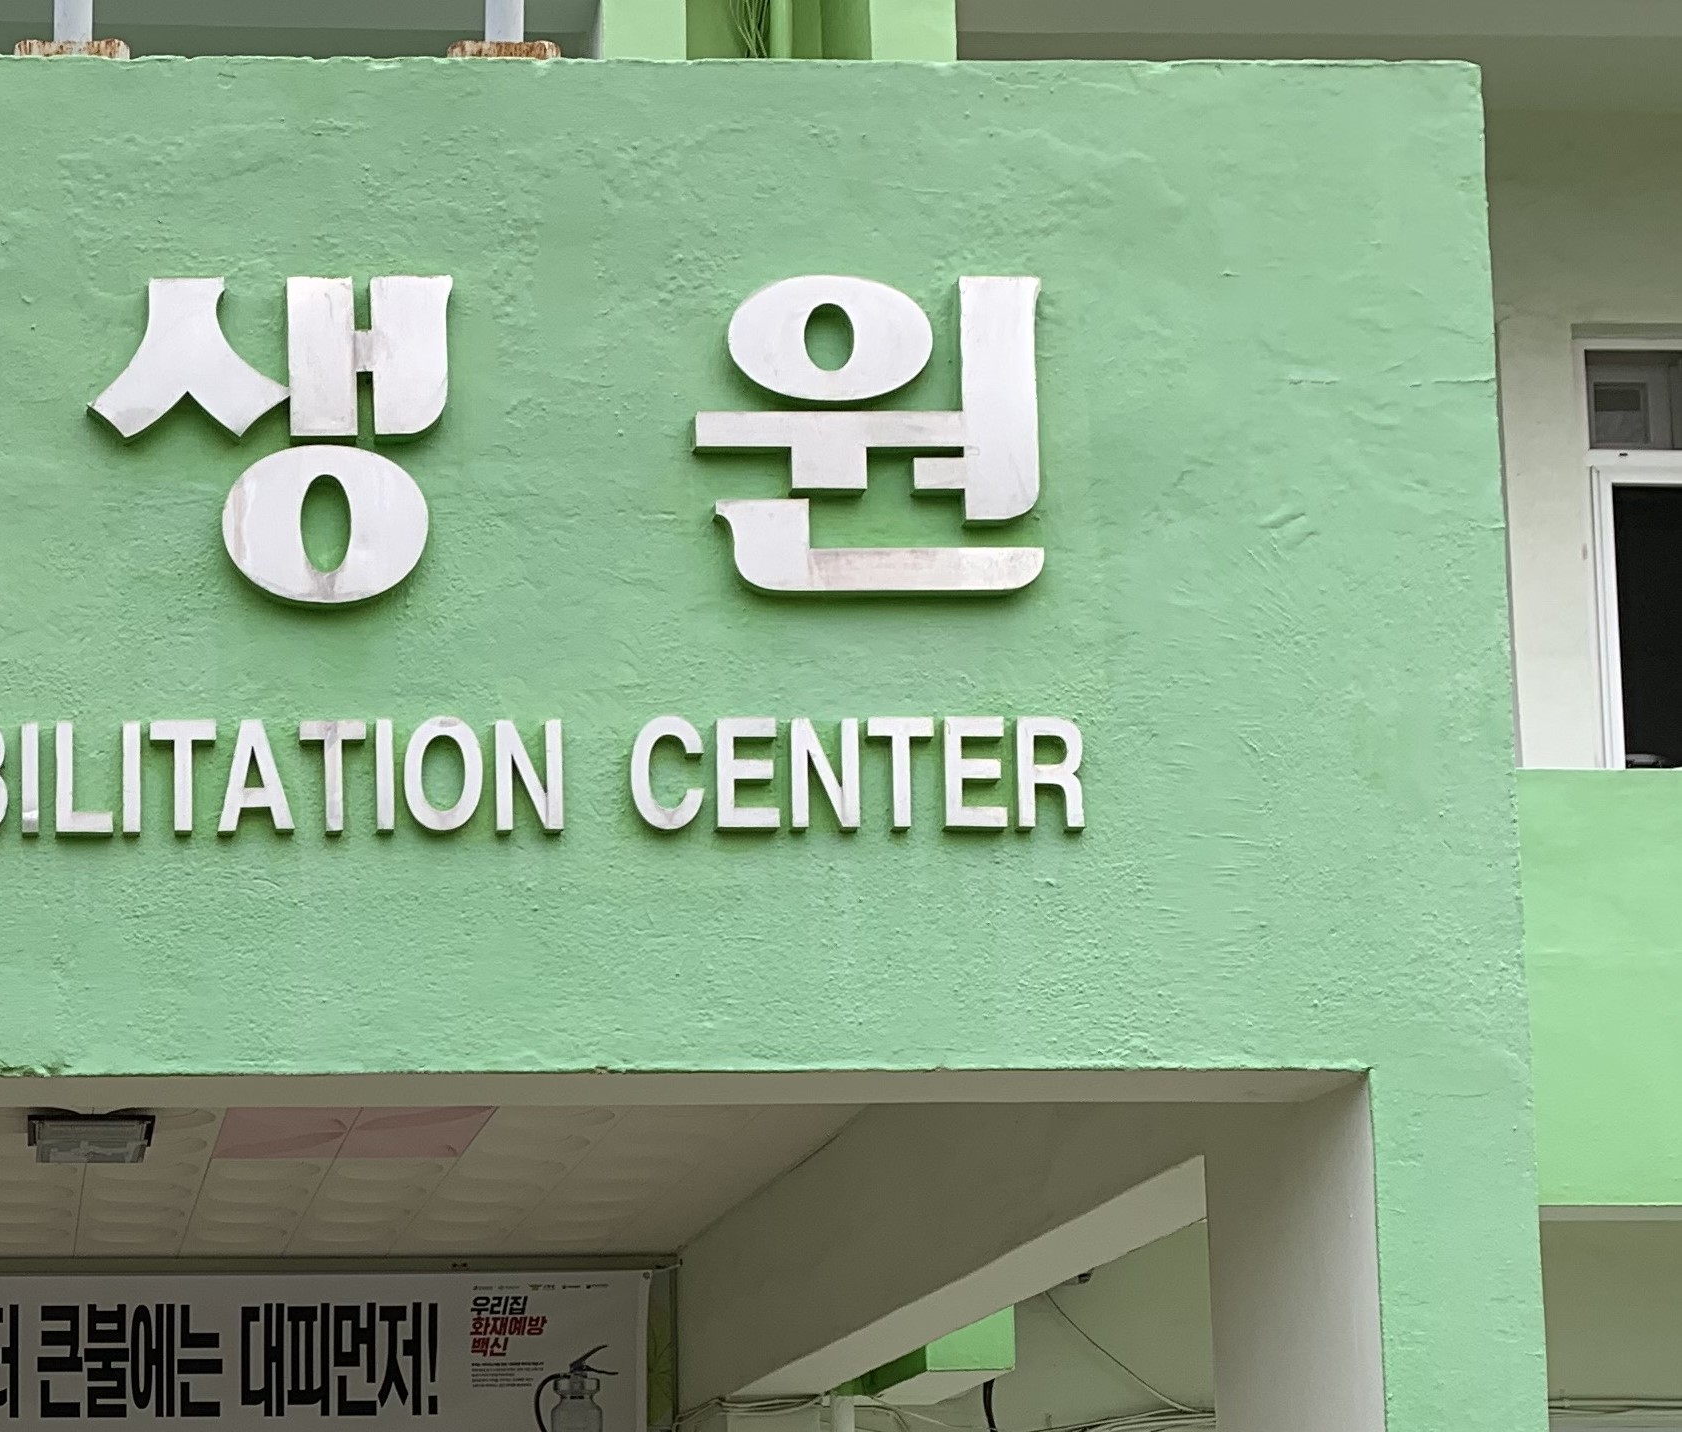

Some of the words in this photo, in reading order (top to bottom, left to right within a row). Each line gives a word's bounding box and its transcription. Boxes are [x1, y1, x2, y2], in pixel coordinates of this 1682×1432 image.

[630, 714, 1086, 834] CENTER
[471, 1296, 528, 1315] 우리집
[470, 1316, 547, 1336] 화재예방
[471, 1337, 508, 1356] 백신
[37, 1304, 222, 1418] 큰불에는
[241, 1302, 438, 1416] 대피먼저!
